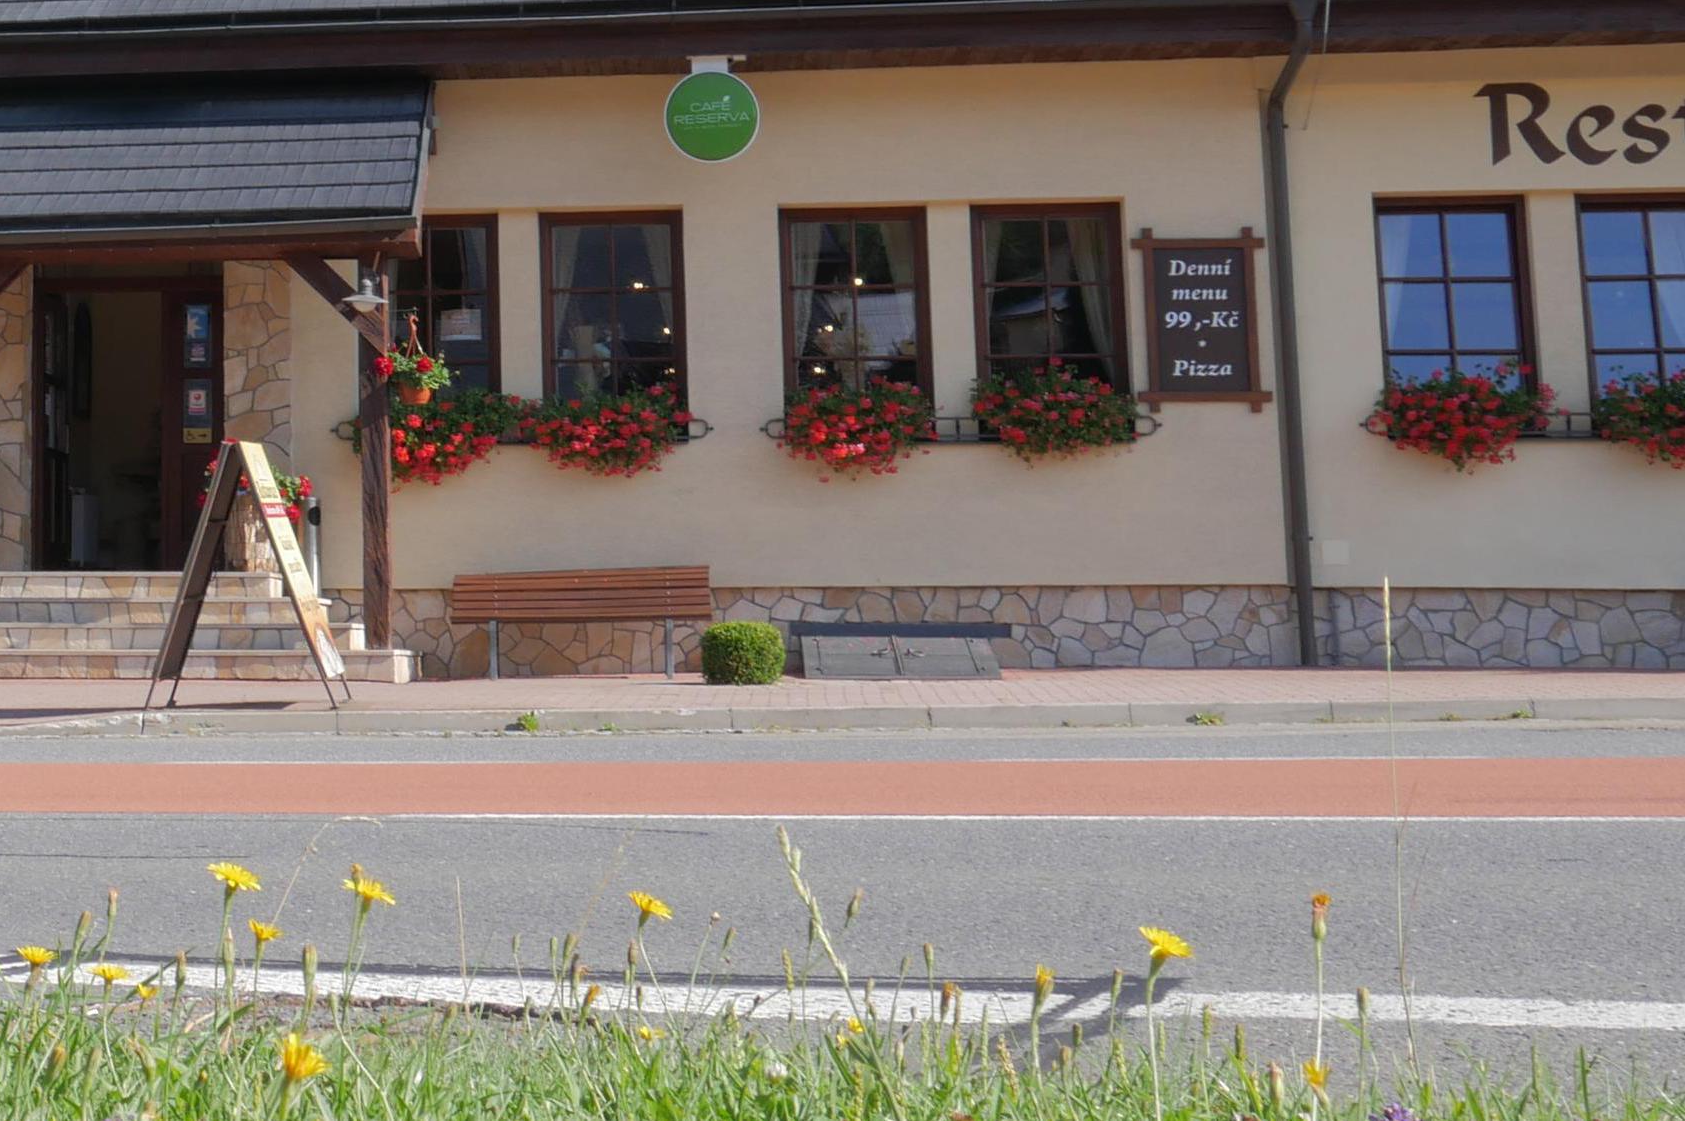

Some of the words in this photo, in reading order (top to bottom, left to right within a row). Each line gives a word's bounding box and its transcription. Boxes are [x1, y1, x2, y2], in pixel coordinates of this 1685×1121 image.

[674, 111, 750, 125] RESERVA
[1168, 259, 1232, 277] Denní
[1171, 288, 1228, 301] menu
[1172, 359, 1233, 377] Pizza
